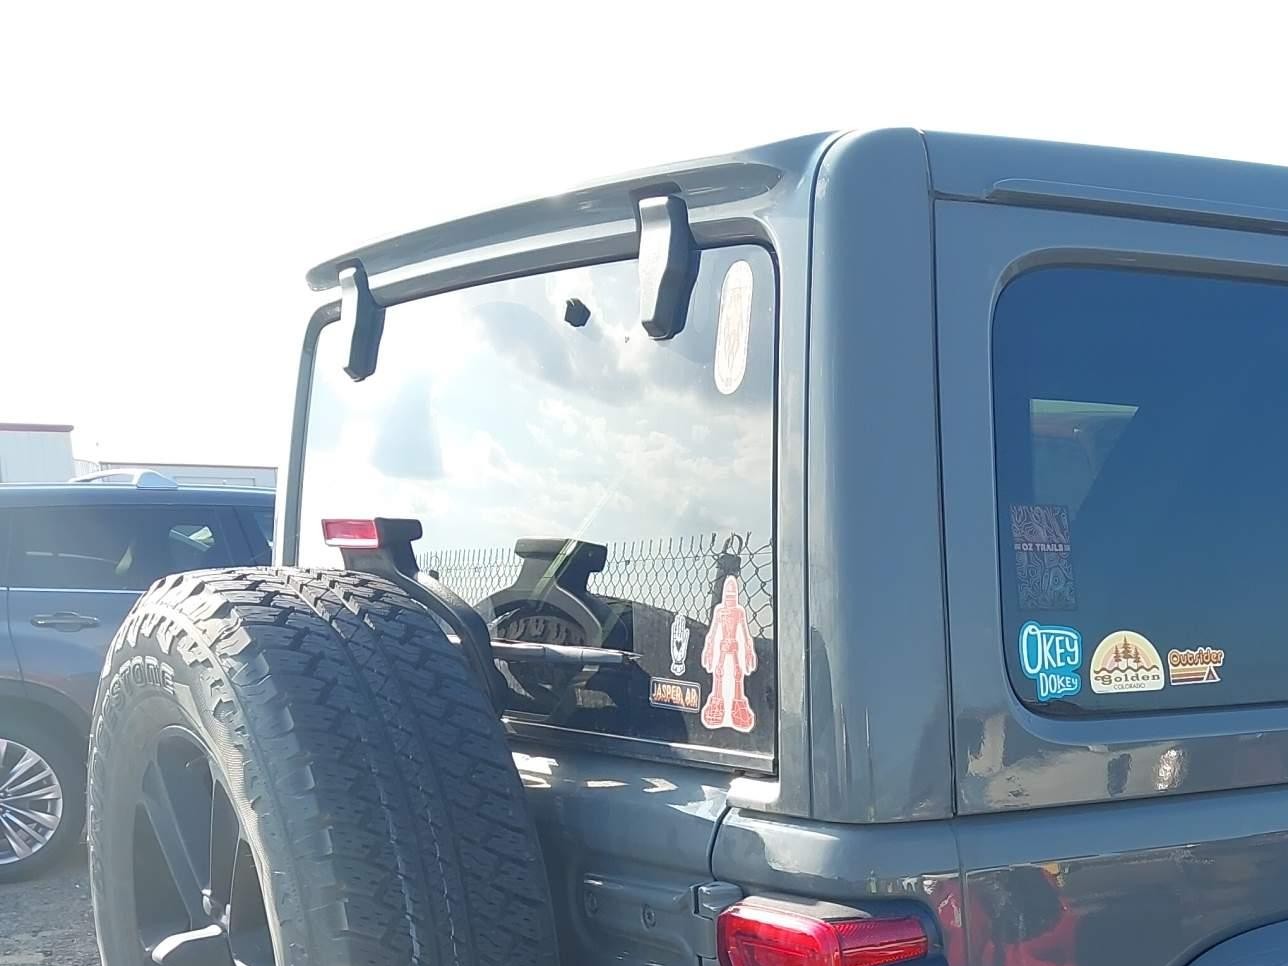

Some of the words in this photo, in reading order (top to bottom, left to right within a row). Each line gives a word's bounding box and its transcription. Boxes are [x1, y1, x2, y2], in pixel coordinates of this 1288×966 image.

[1021, 543, 1033, 551] OZ
[1022, 624, 1079, 674] OKEY
[1170, 649, 1222, 667] Outsider
[1039, 672, 1078, 697] DOKEY
[1113, 682, 1146, 690] COLORADO
